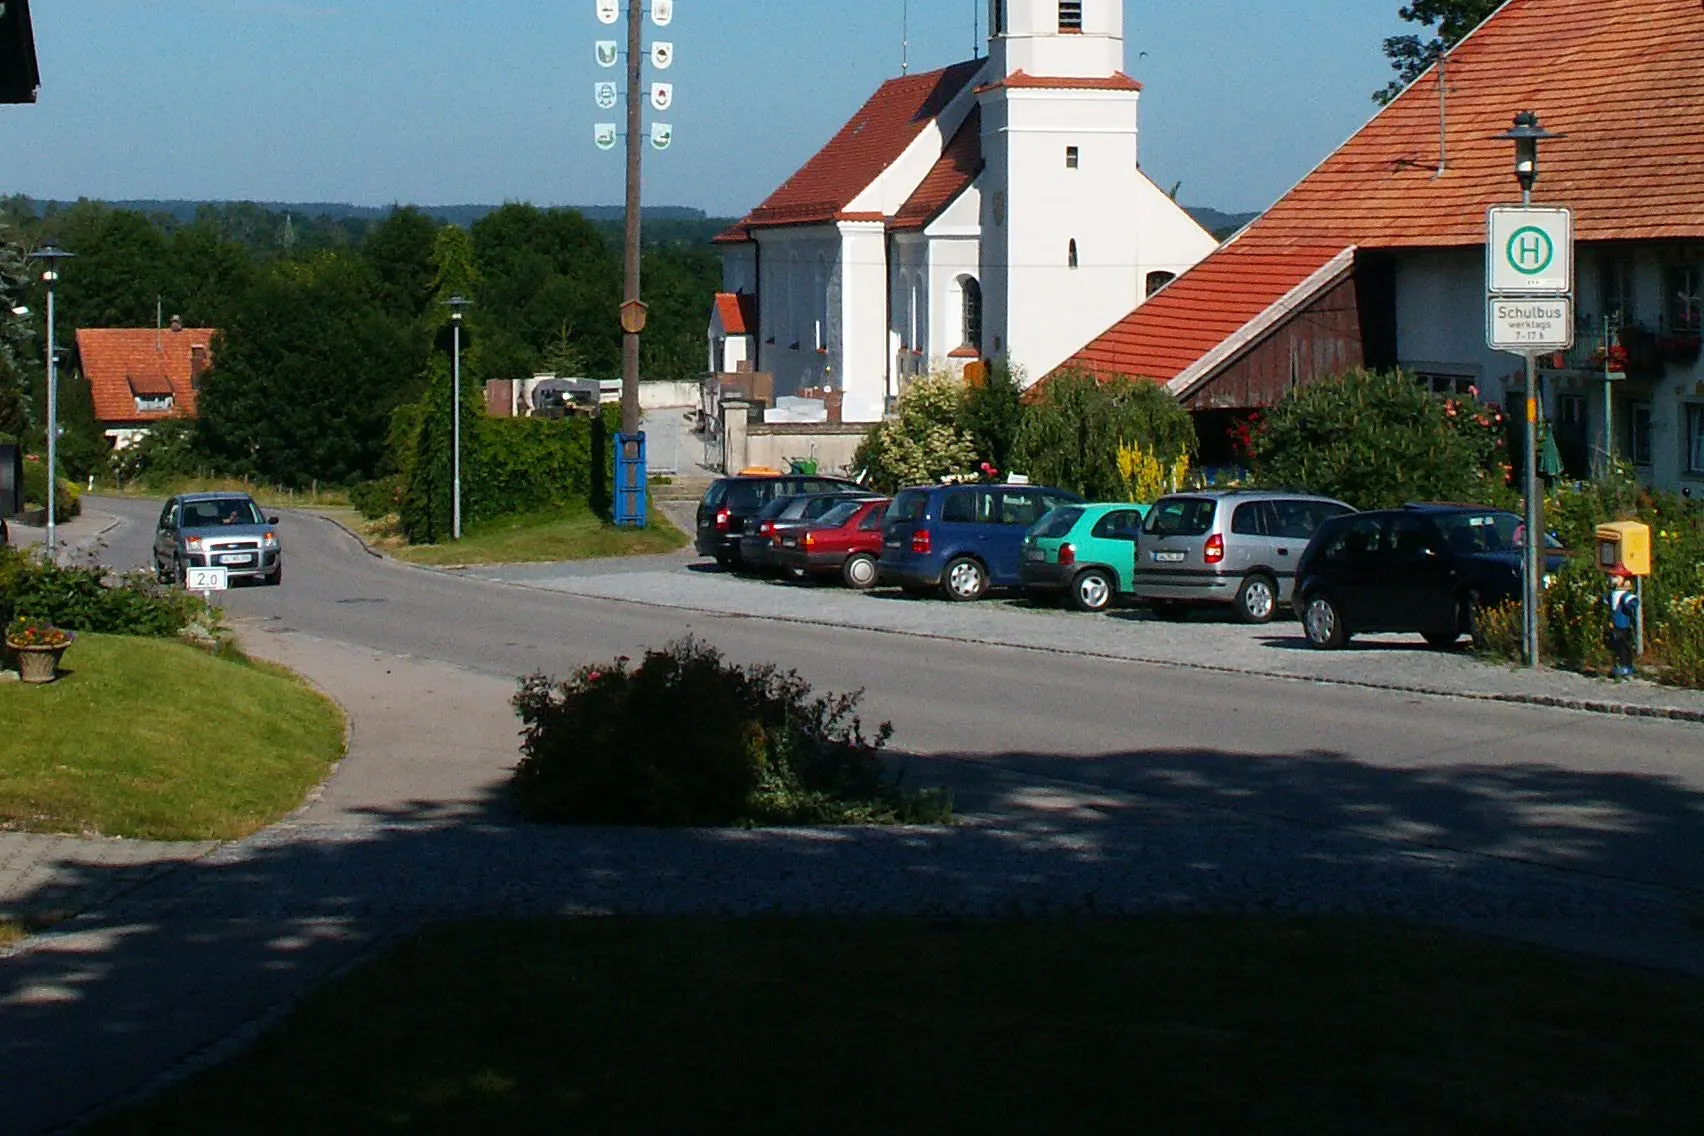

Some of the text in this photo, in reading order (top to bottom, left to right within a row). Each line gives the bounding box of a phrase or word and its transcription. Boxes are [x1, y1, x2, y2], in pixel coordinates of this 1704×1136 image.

[1520, 237, 1539, 264] H
[1498, 306, 1561, 319] Schulbus
[1508, 321, 1552, 330] werktags
